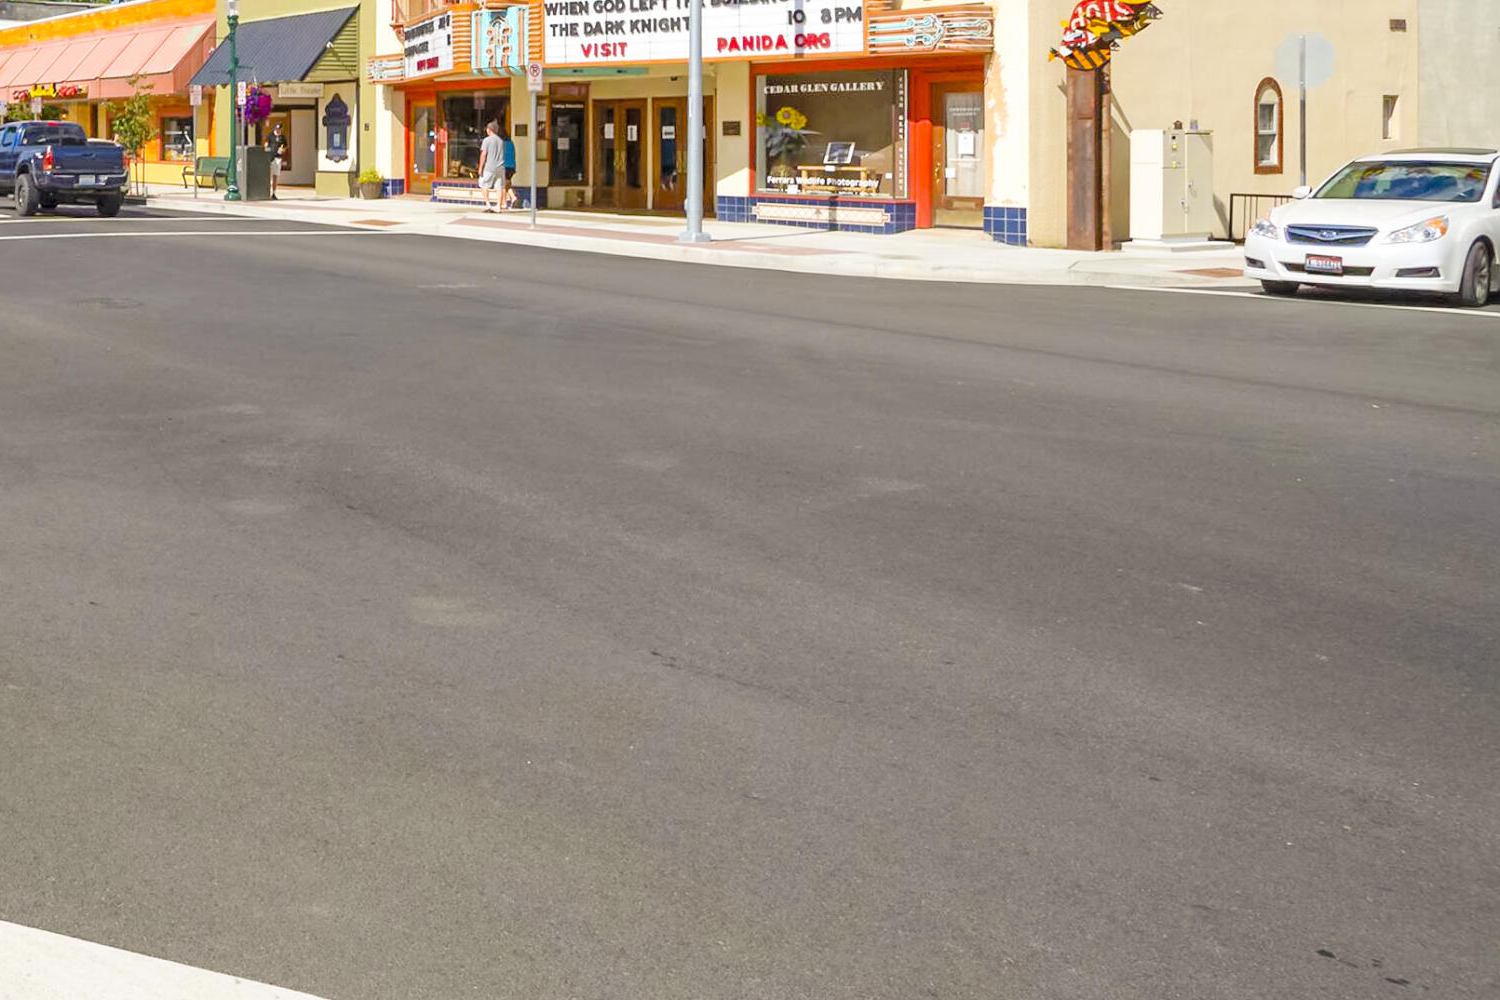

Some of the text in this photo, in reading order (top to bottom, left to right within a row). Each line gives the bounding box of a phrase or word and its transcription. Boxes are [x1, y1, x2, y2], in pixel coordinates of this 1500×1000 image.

[545, 1, 589, 16] WHEN
[593, 0, 625, 14] GOD
[550, 22, 579, 37] THE
[583, 20, 626, 36] DARK
[630, 16, 690, 34] KNIGHT
[581, 33, 831, 58] VISIT PANIDA ORG
[764, 81, 885, 95] CEDAR GLEN GALLERY
[796, 177, 825, 185] Wildlife
[826, 178, 879, 188] Photography
